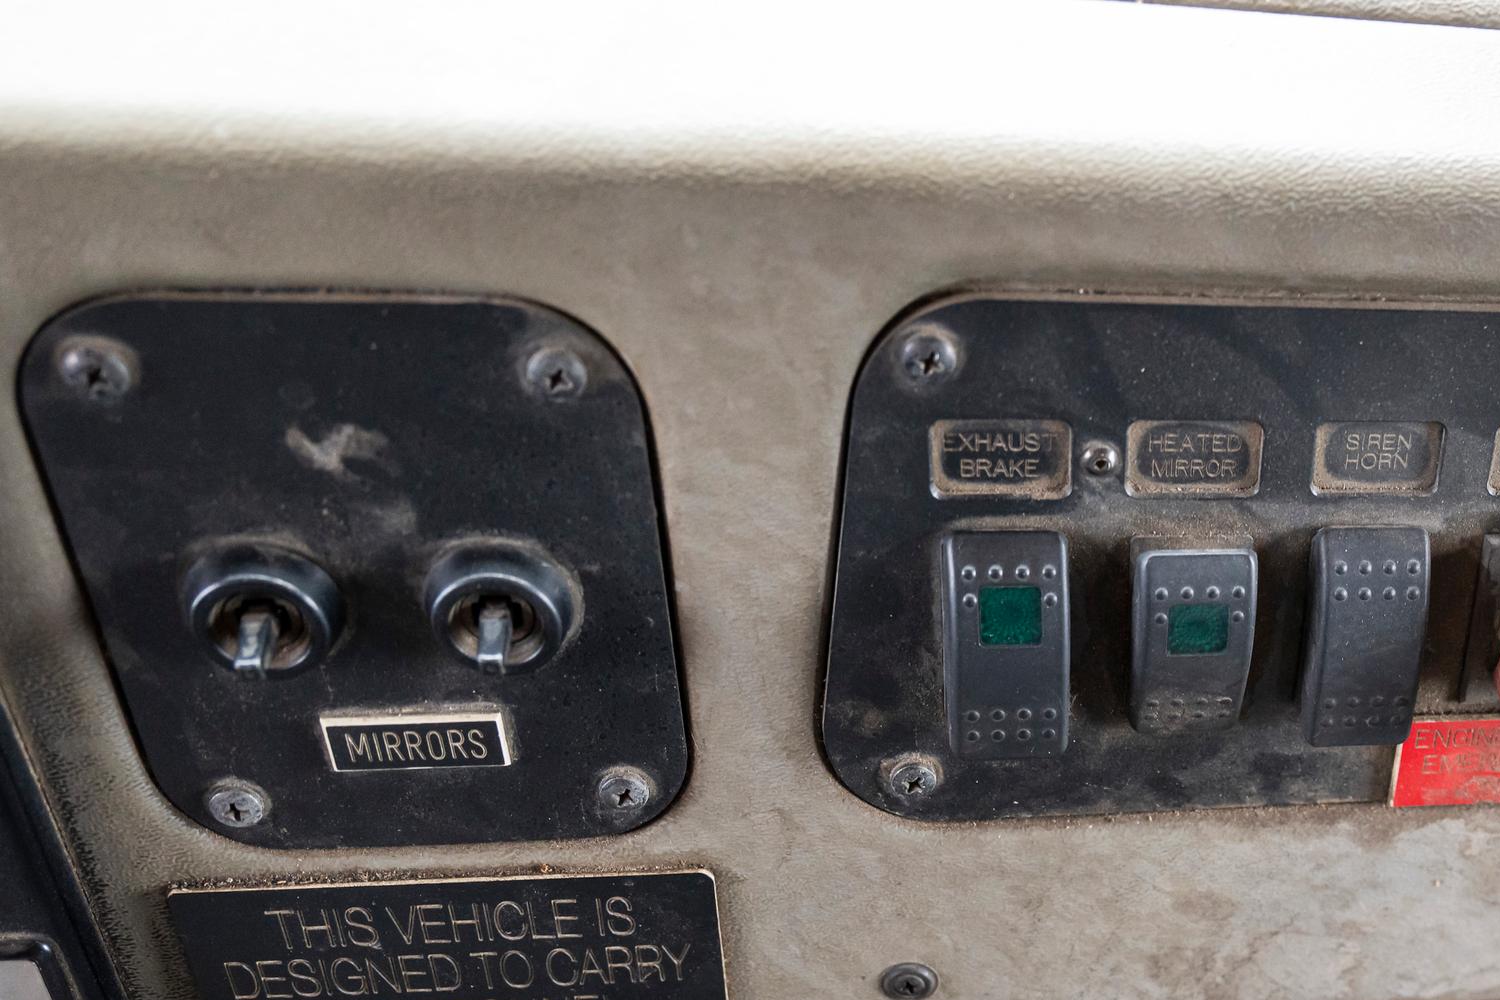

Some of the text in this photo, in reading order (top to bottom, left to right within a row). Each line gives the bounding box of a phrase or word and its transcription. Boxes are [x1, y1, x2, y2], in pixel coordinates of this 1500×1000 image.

[943, 432, 1057, 452] EXHAUST
[1148, 433, 1242, 453] HEATED
[1346, 433, 1412, 451] SIREN
[959, 458, 1040, 478] BRAKE
[1150, 458, 1237, 478] MIRROR
[1344, 452, 1409, 470] HORN
[344, 728, 488, 763] MIRRORS
[264, 895, 637, 950] THIS VEHICLE IS
[223, 942, 692, 1000] DESIGNED TO CARRY
